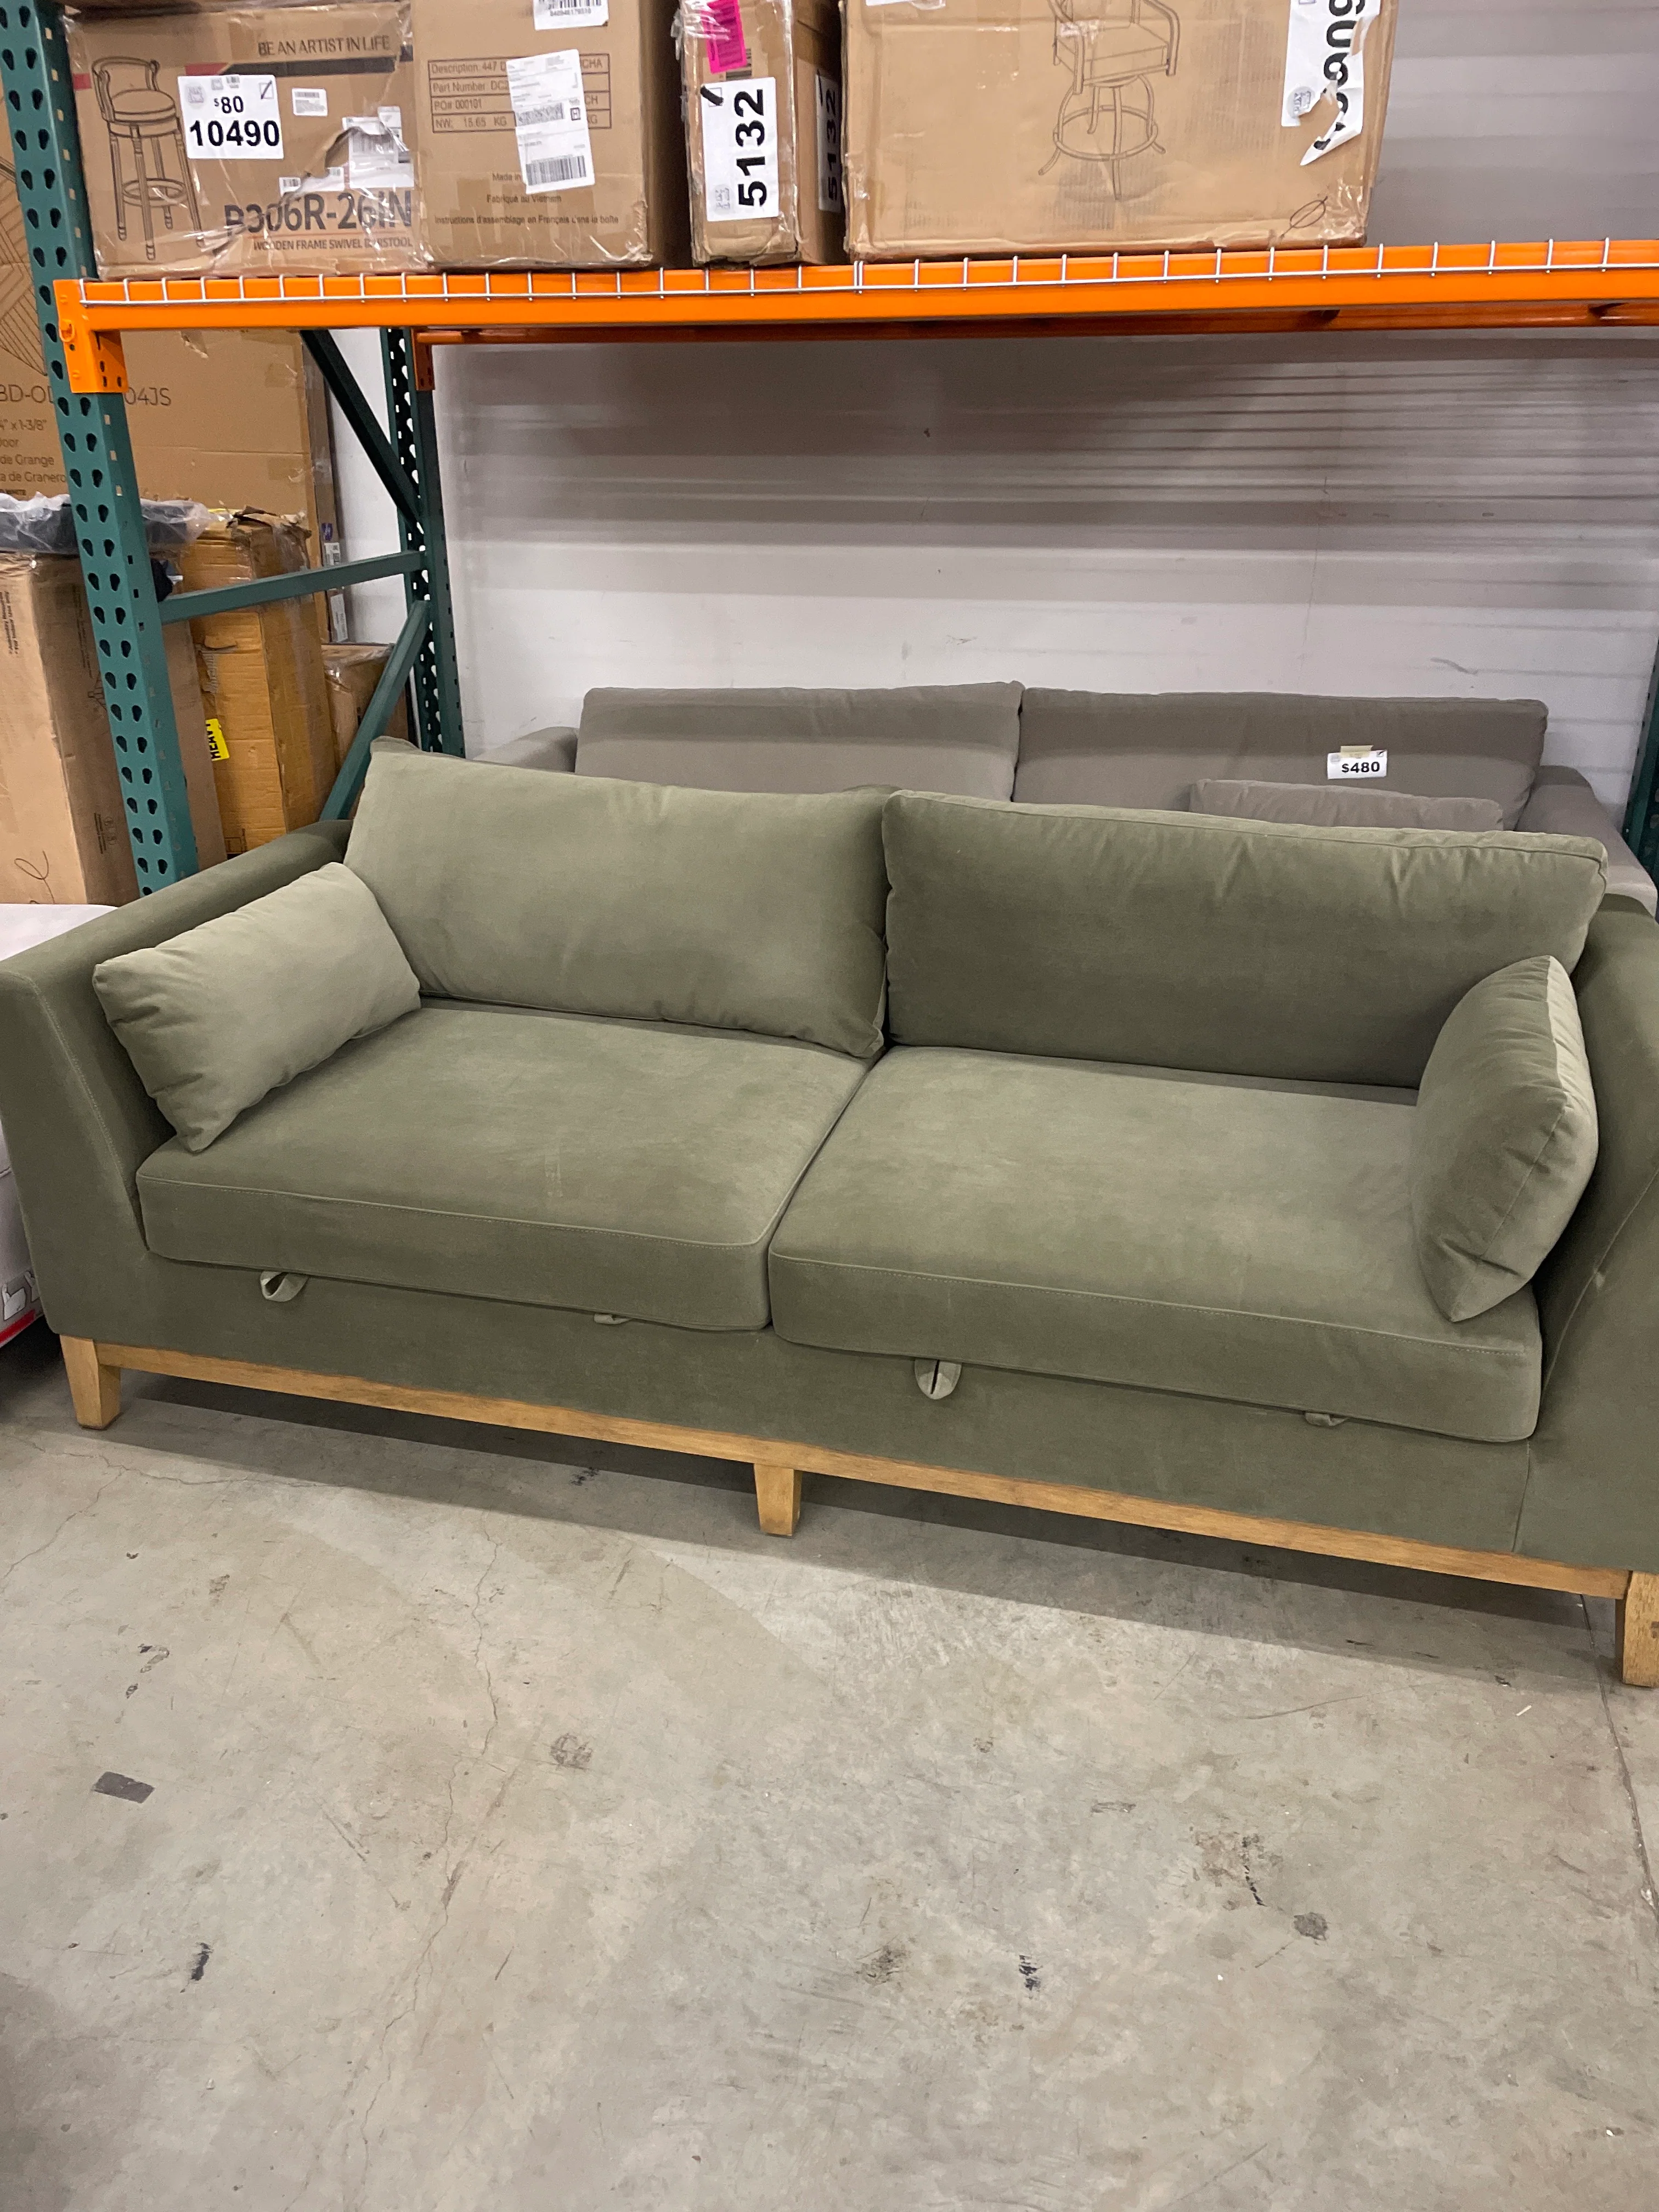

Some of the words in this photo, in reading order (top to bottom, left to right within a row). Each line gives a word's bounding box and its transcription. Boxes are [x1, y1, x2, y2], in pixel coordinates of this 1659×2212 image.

[258, 42, 274, 55] BE
[278, 40, 296, 54] AN
[298, 37, 344, 53] ARTIST
[346, 36, 360, 52] IN
[580, 57, 603, 68] CHA
[453, 81, 485, 92] Number
[214, 95, 244, 114] $80
[494, 115, 507, 126] KG
[190, 120, 280, 146] 10490
[734, 88, 768, 207] 5132
[253, 240, 294, 250] WODEN
[296, 239, 328, 250] FRAME
[329, 238, 363, 249] SWIVEL
[15, 454, 54, 467] Grange
[1341, 761, 1380, 773] $480
